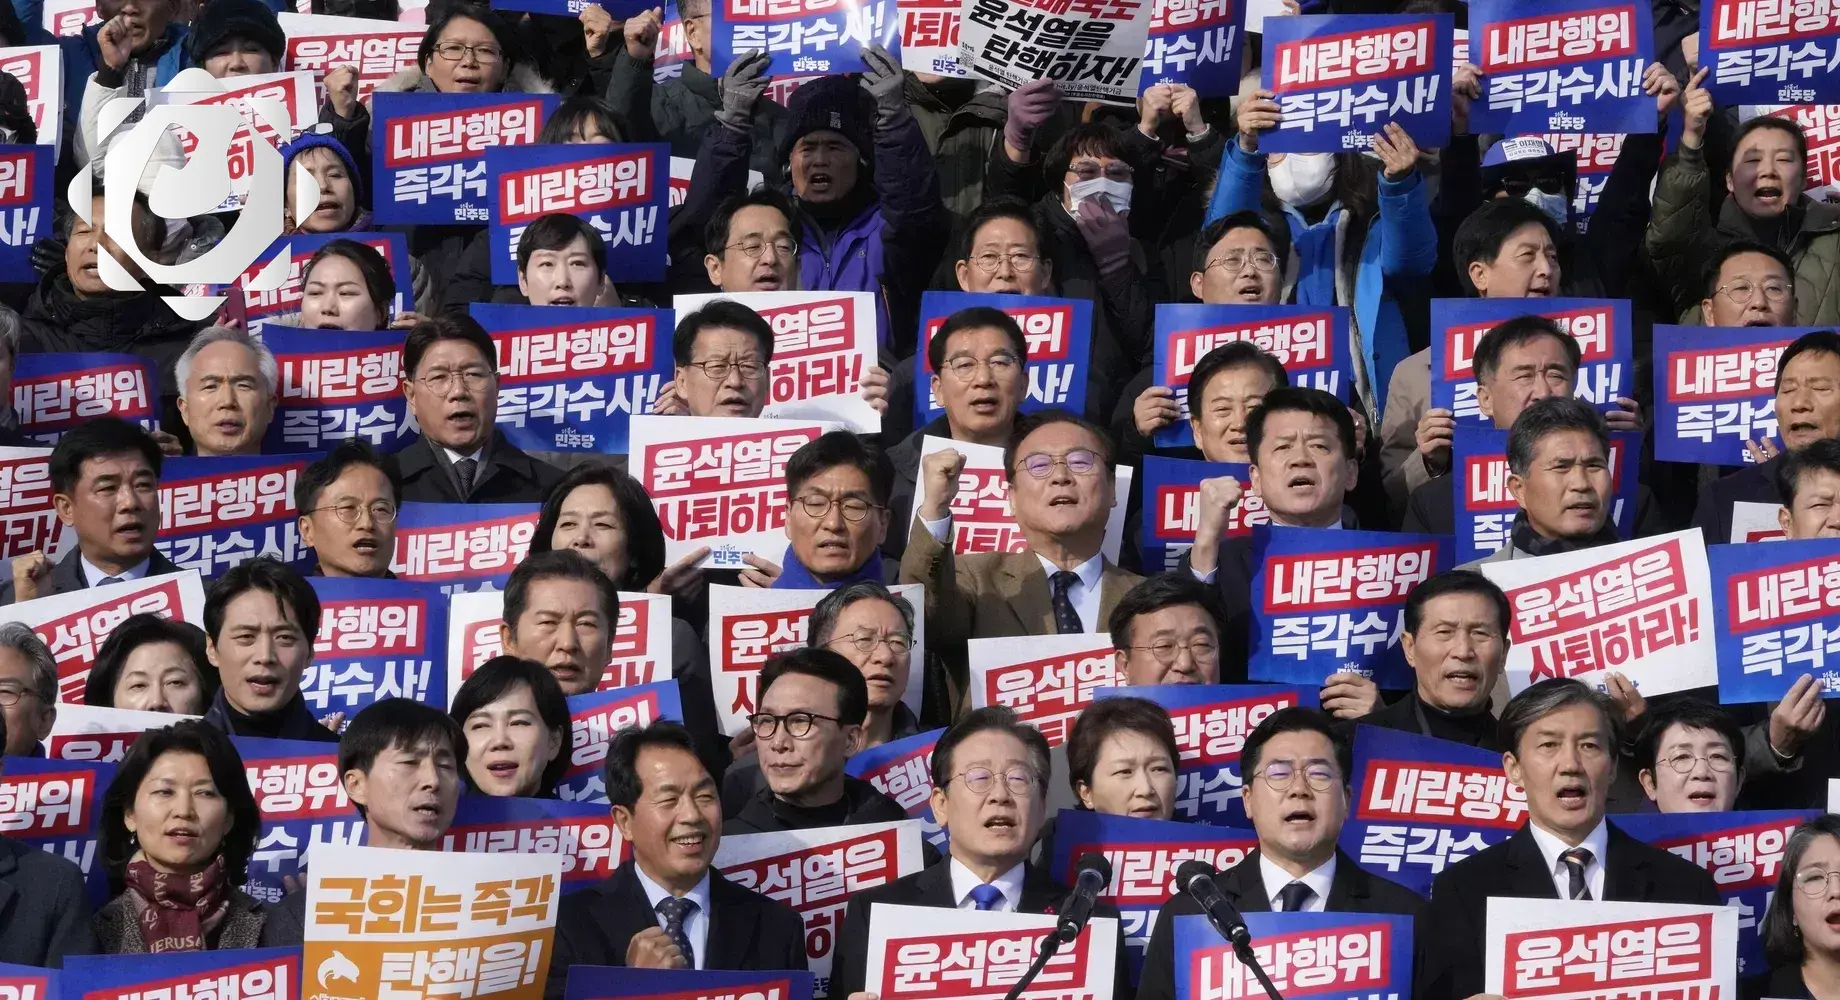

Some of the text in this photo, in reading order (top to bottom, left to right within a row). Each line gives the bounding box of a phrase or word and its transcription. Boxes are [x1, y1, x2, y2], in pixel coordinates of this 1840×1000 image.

[968, 0, 1115, 51] 윤석열을
[1490, 12, 1630, 66] 내란행위
[793, 59, 830, 72] 민주당
[981, 34, 1140, 86] 탄핵하자!
[1280, 28, 1428, 85] 내란행위
[1280, 74, 1440, 132] 즉각수사!
[1488, 58, 1645, 113] 즉각수사!
[1778, 88, 1816, 102] 민주당
[393, 107, 535, 160] 내란행위
[1549, 116, 1586, 130] 민주당
[506, 157, 647, 215] 내란행위
[496, 323, 647, 378] 내란행위
[770, 304, 846, 352] 열은
[283, 352, 406, 400] 내란행
[495, 374, 661, 429] 즉각수사!
[764, 354, 863, 405] 하라!
[555, 433, 594, 449] 민주당
[653, 435, 809, 491] 윤석열은
[1272, 549, 1431, 605] 내란행위
[1515, 549, 1675, 635] 윤석열은
[35, 591, 173, 660] 석열은
[1529, 597, 1699, 685] 사퇴하라!
[996, 653, 1128, 712] 윤석열
[249, 762, 349, 813] 행위
[1368, 768, 1530, 821] 내란행위
[1360, 826, 1513, 875] 즉각수
[315, 874, 555, 934] 국회는 즉각
[377, 939, 544, 1000] 탄핵을!
[893, 937, 1077, 993] 윤석열은
[1200, 931, 1381, 1000] 내란행위
[1515, 922, 1701, 990] 윤석열은
